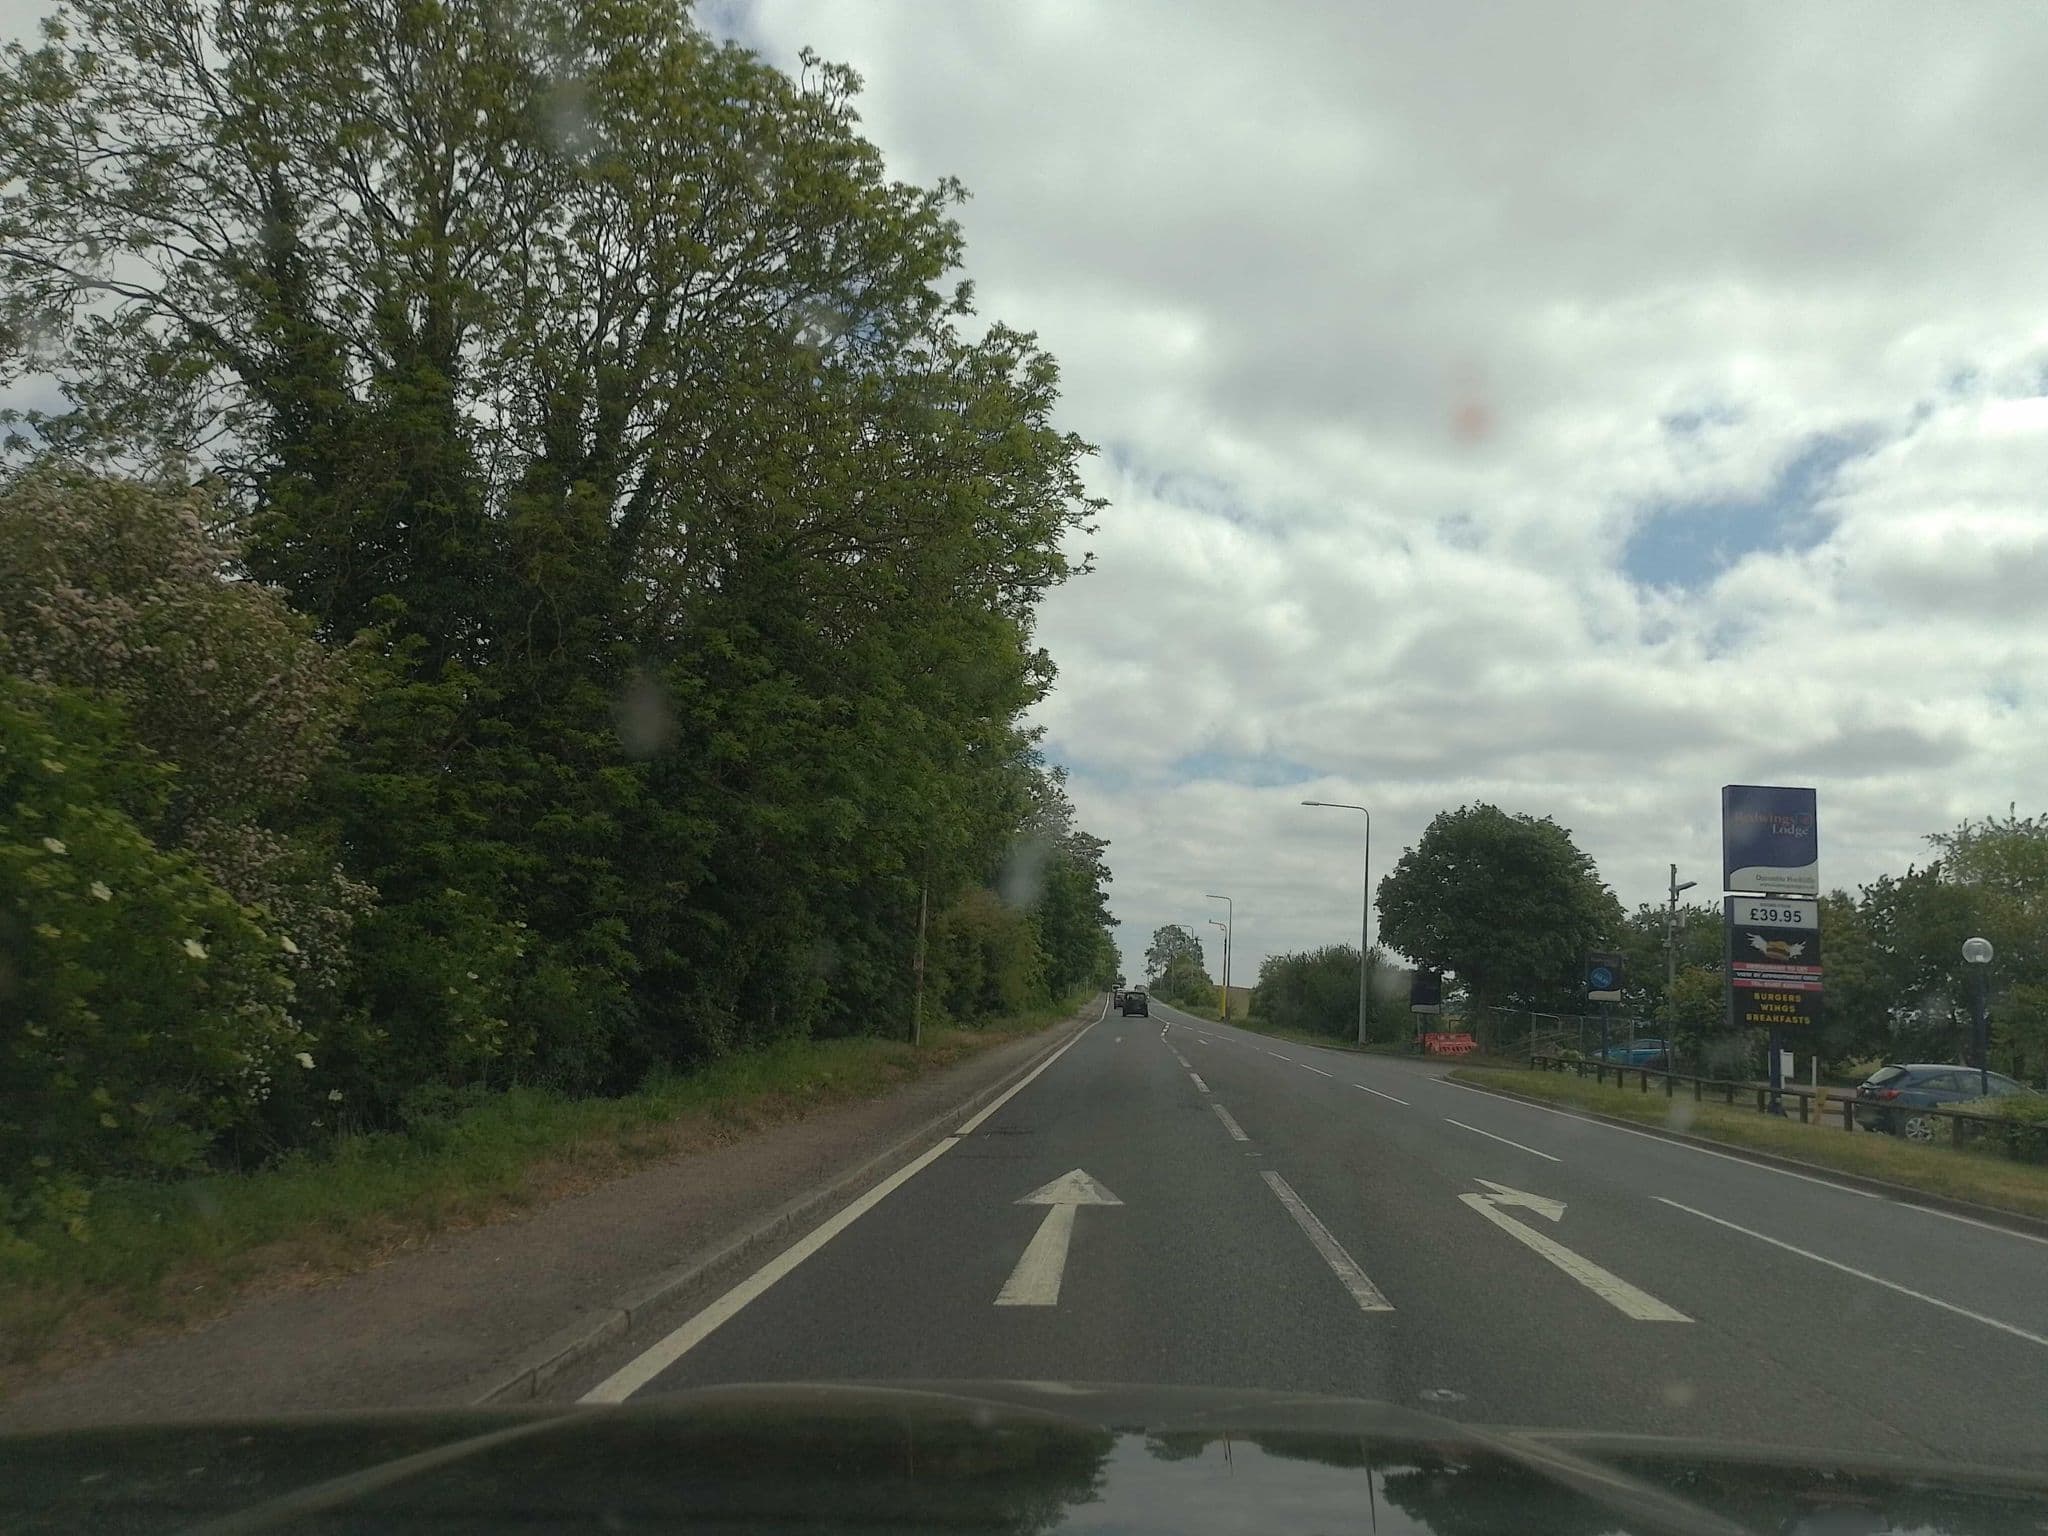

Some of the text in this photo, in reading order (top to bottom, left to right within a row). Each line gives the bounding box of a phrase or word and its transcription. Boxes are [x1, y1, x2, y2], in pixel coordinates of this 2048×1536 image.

[1772, 823, 1809, 838] Lodge
[1750, 908, 1802, 923] £39.95
[1754, 992, 1801, 1002] BURGERS
[1760, 1003, 1796, 1013] WINGS
[1745, 1013, 1811, 1025] BREAKFASTS
